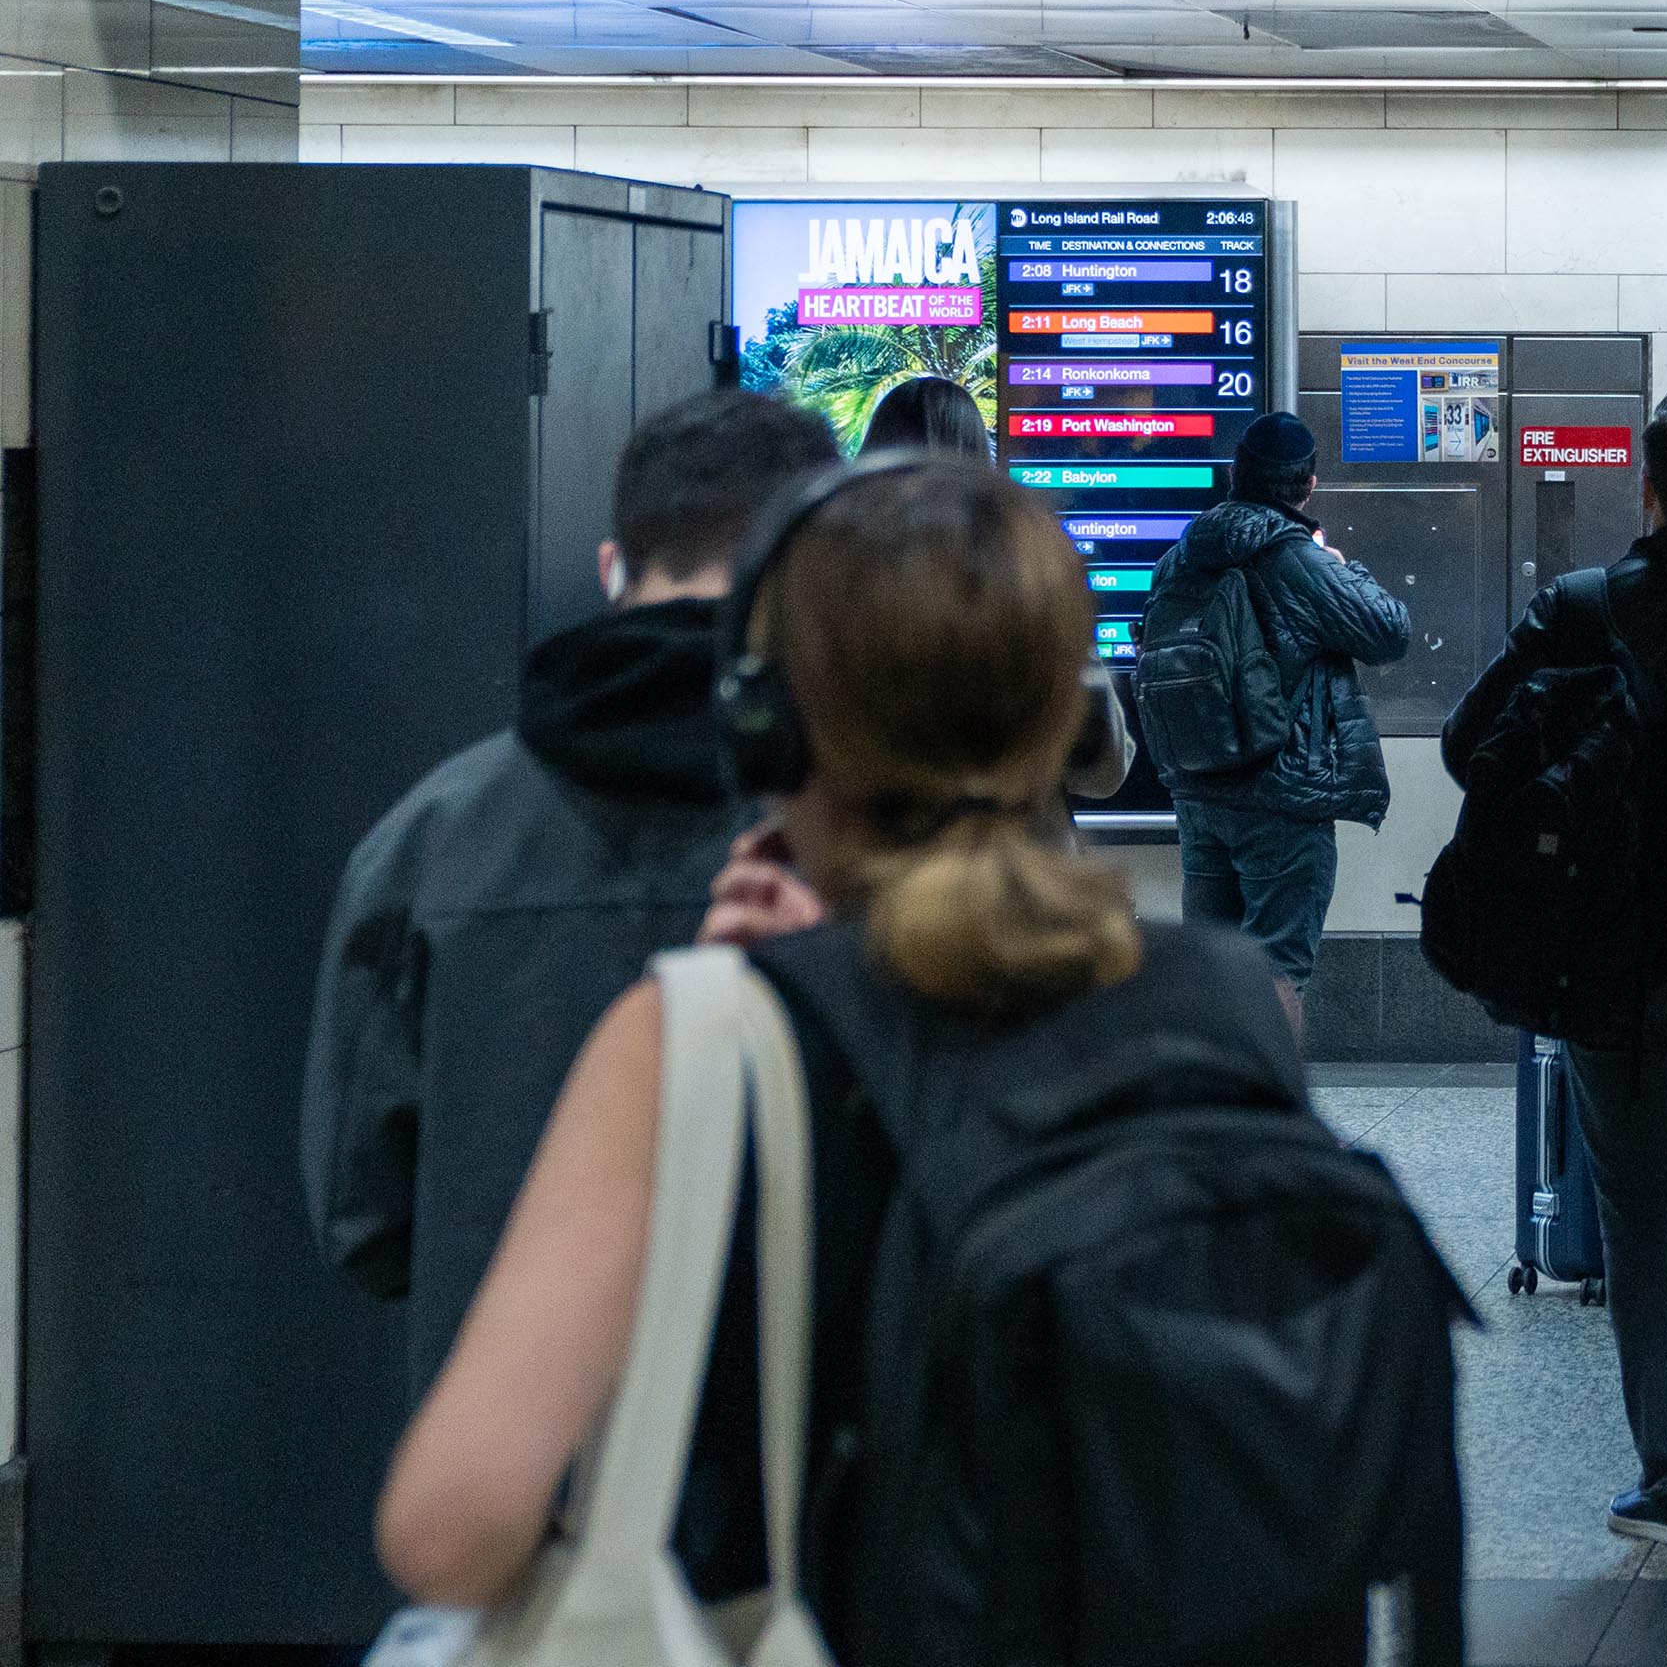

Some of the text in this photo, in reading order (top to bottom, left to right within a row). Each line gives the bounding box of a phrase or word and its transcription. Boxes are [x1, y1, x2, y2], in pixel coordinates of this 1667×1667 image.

[1031, 212, 1254, 226] Long Island Rail Road 2:06:48
[798, 218, 981, 283] JAMAICA
[1029, 241, 1254, 250] TIME DESTINATION & CONNECTIONS TRACK
[1022, 264, 1136, 280] 2:08 Huntington
[1219, 269, 1252, 293] 18
[804, 295, 925, 317] HEARTBEAT
[929, 295, 973, 305] OF THE
[929, 307, 974, 317] WORLD
[1022, 316, 1143, 331] 2:11 Long Beach
[1219, 320, 1252, 345] 16
[1347, 356, 1492, 365] Visit the West End Concourse
[1022, 368, 1150, 380] 2:14 Ronkonkoma
[1449, 376, 1479, 387] LIRR
[1218, 373, 1252, 396] 20
[1447, 405, 1461, 425] 33
[1022, 419, 1174, 434] 2:19 Port Washington
[1523, 431, 1555, 445] FIRE
[1523, 448, 1627, 463] EXTINGUISHER
[1022, 470, 1117, 486] 2:22 Babylon
[1114, 646, 1133, 655] JFK
